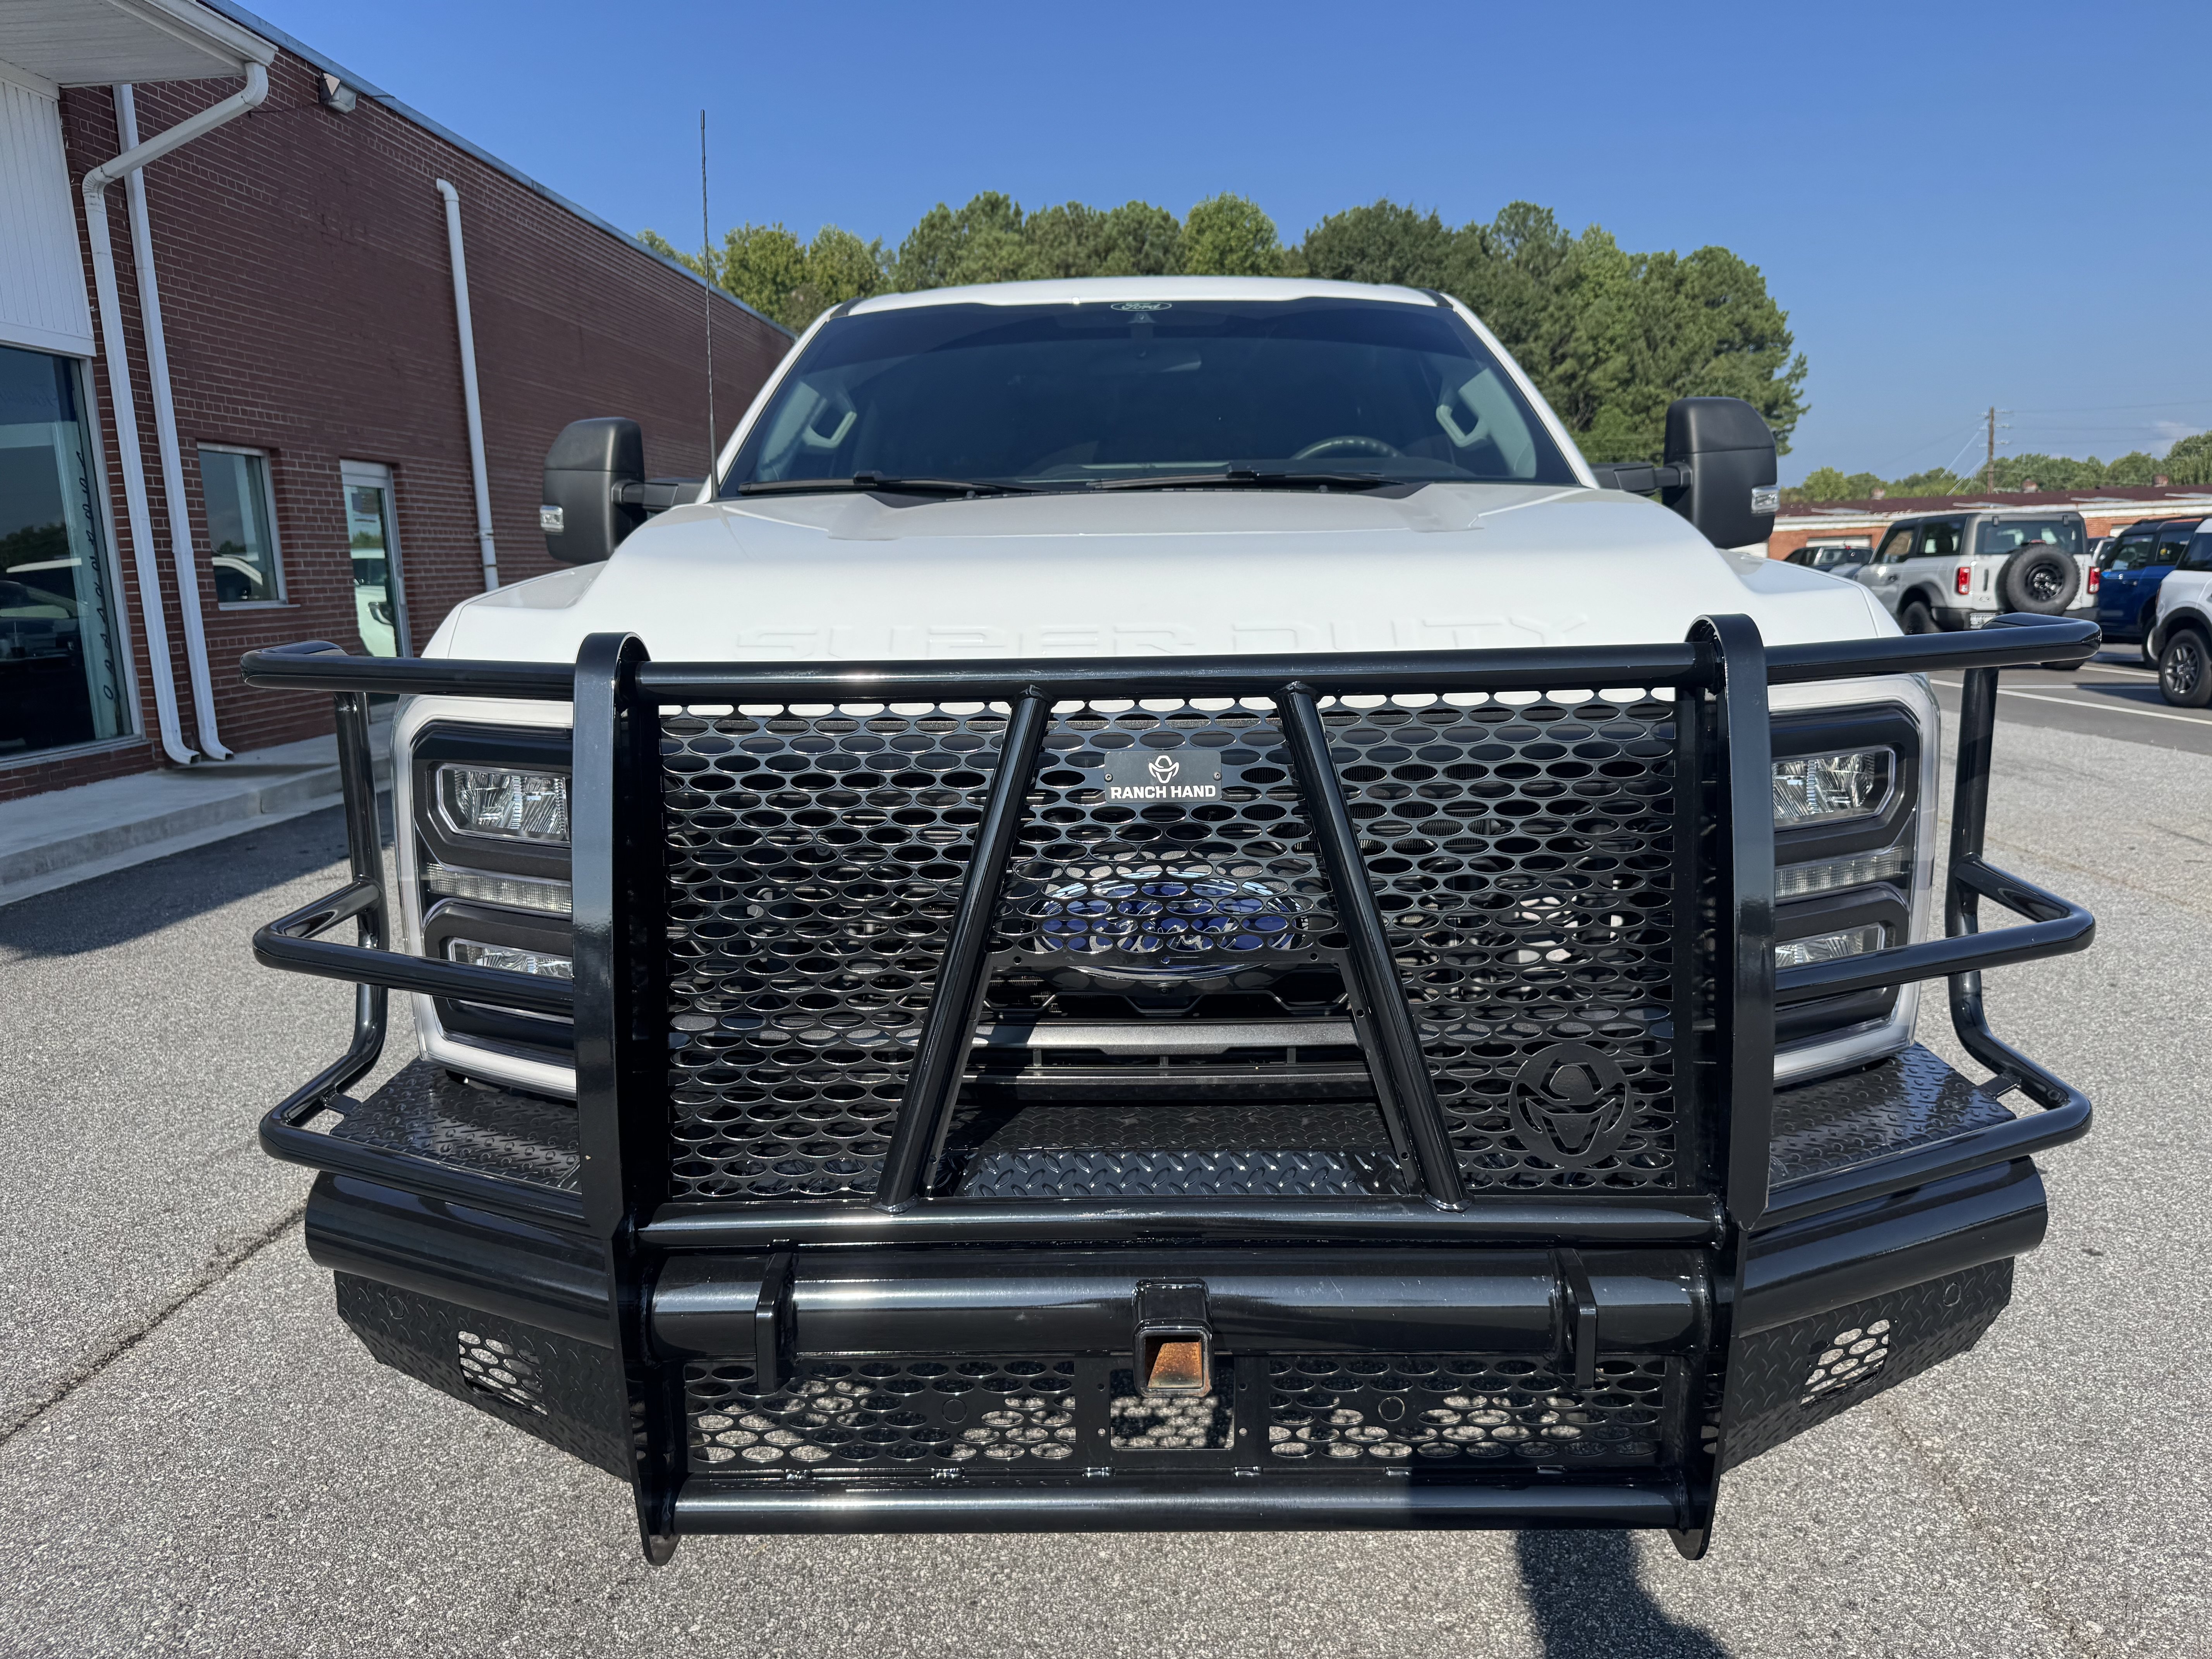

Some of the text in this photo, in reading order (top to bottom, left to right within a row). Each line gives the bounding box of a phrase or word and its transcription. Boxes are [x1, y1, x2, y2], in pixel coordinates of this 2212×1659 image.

[1121, 302, 1161, 310] Ford
[1110, 785, 1216, 799] RANCH HAND
